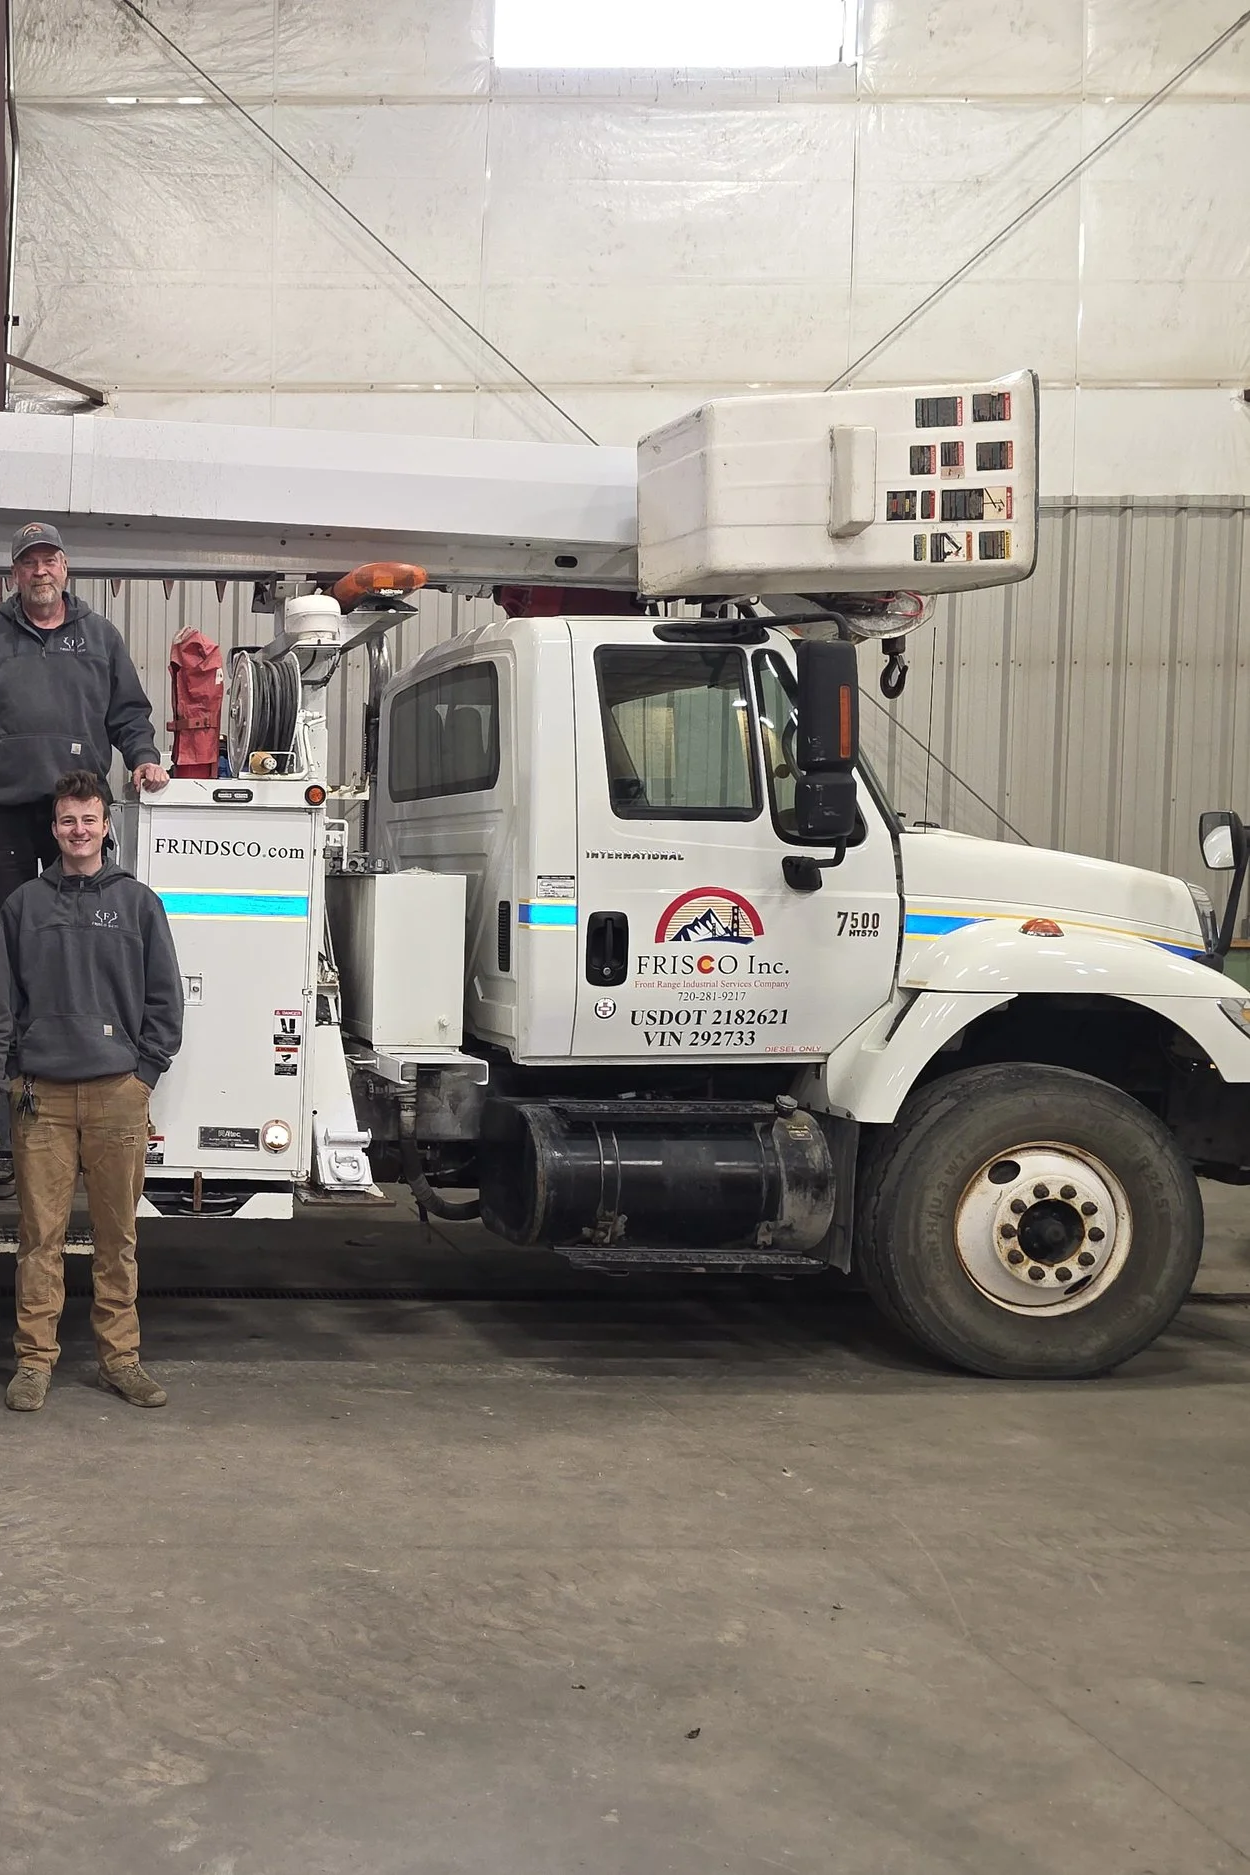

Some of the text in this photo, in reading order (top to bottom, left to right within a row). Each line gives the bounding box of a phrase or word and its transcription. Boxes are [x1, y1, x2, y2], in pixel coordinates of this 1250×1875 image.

[154, 838, 304, 859] FRINDSCO.com
[586, 850, 684, 860] INTERNATIONAL
[837, 911, 880, 936] 7500
[636, 955, 790, 974] FRISCO Inc.
[657, 981, 681, 989] Range
[754, 980, 790, 989] Company
[678, 992, 746, 1001] 720-281-9217
[630, 1009, 788, 1026] USDOT 2182621
[644, 1031, 756, 1046] VIN 292733
